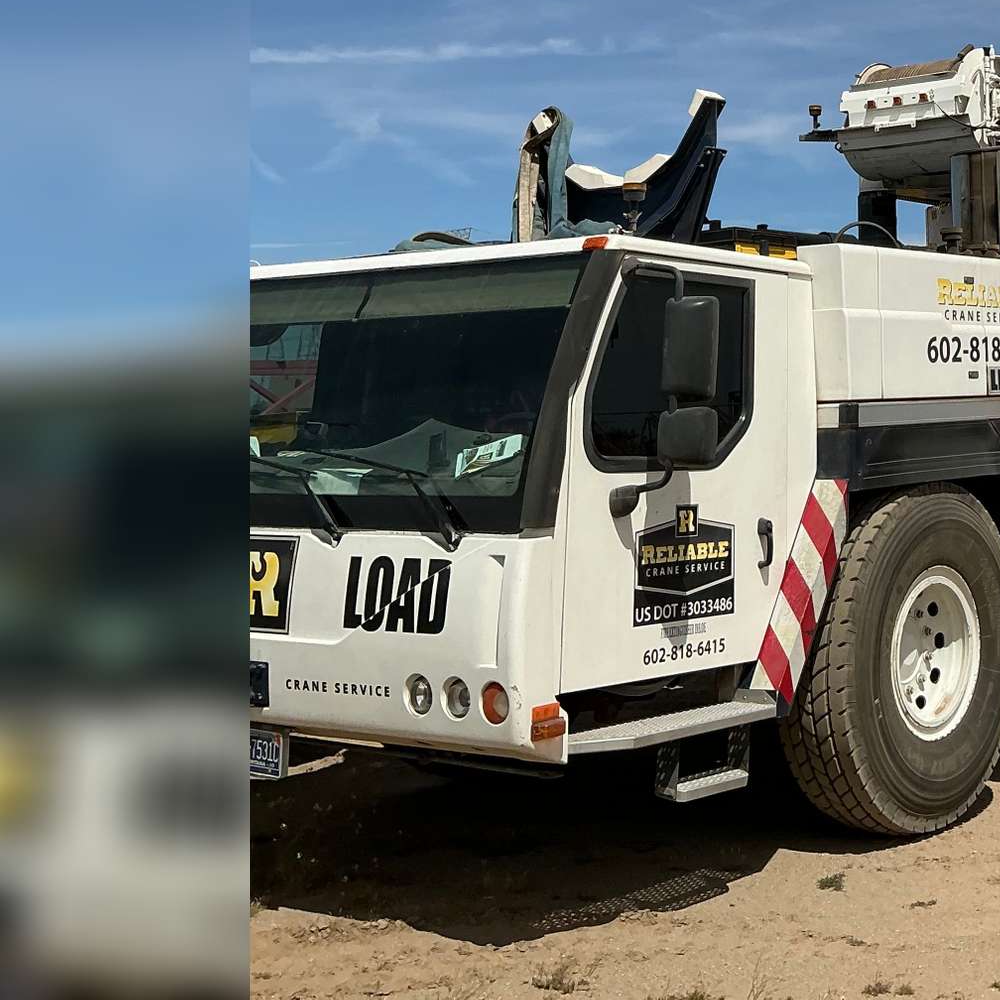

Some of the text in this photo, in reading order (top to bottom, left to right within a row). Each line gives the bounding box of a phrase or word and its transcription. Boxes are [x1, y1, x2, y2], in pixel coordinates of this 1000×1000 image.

[944, 309, 982, 322] CRANE
[641, 540, 729, 565] RELIABLE
[646, 560, 726, 578] CRANE SERVICE
[343, 555, 453, 635] LOAD
[635, 597, 733, 623] US DOT #3033486
[643, 637, 726, 666] 602-818-6415
[286, 679, 390, 698] CRANE SERVICE
